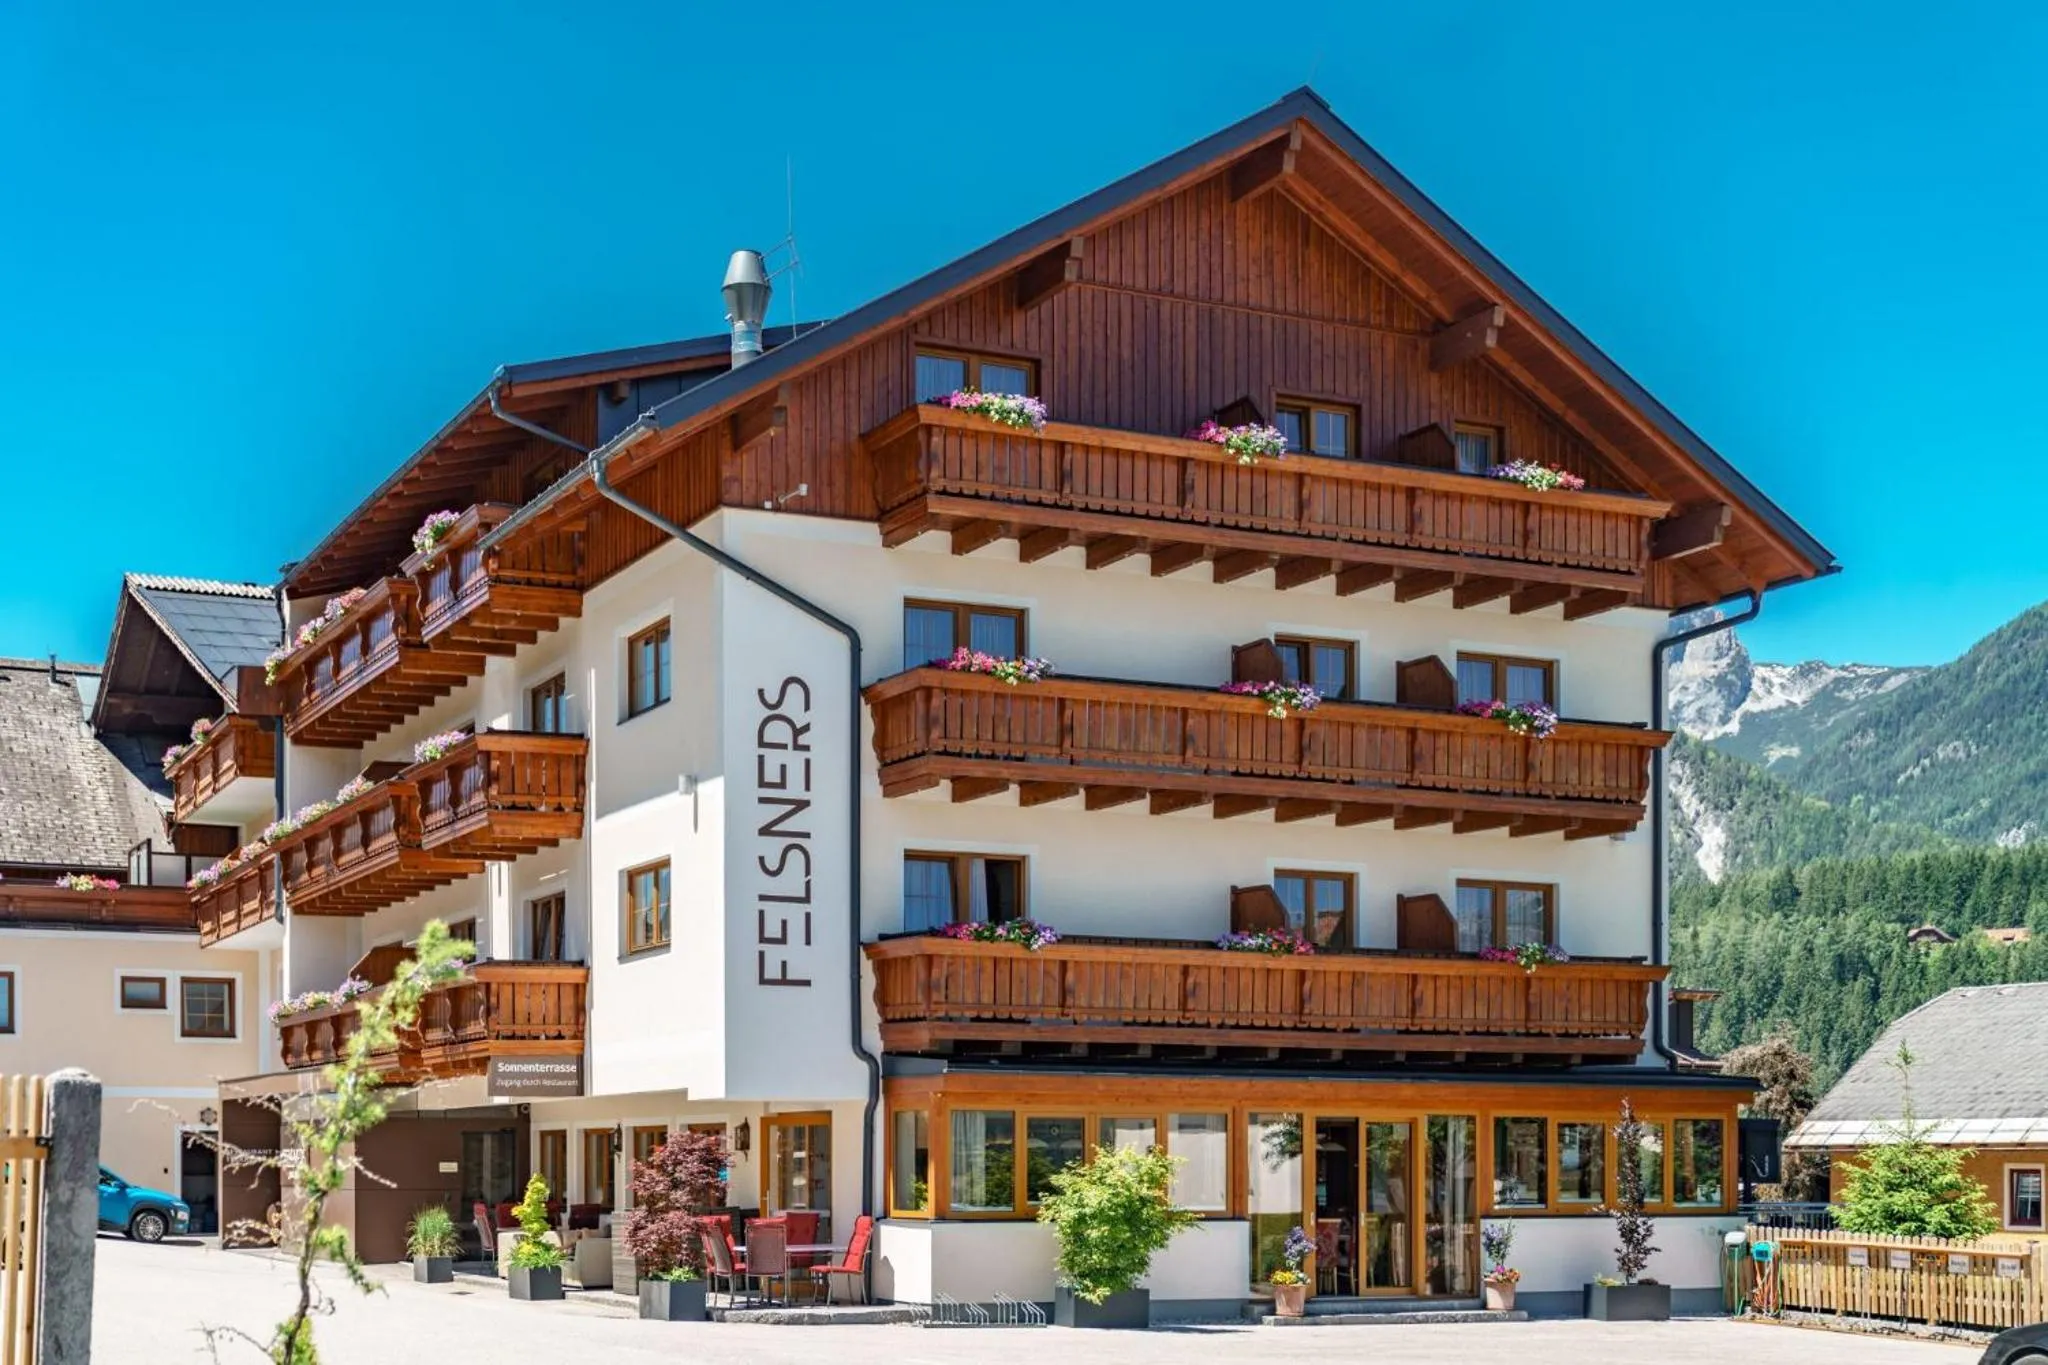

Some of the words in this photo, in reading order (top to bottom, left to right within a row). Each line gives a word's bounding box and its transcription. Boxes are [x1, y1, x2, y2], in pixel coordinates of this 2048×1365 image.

[758, 676, 811, 987] FELSNERS
[497, 1062, 577, 1073] Sonnenterrasse
[495, 1079, 521, 1088] Zugang
